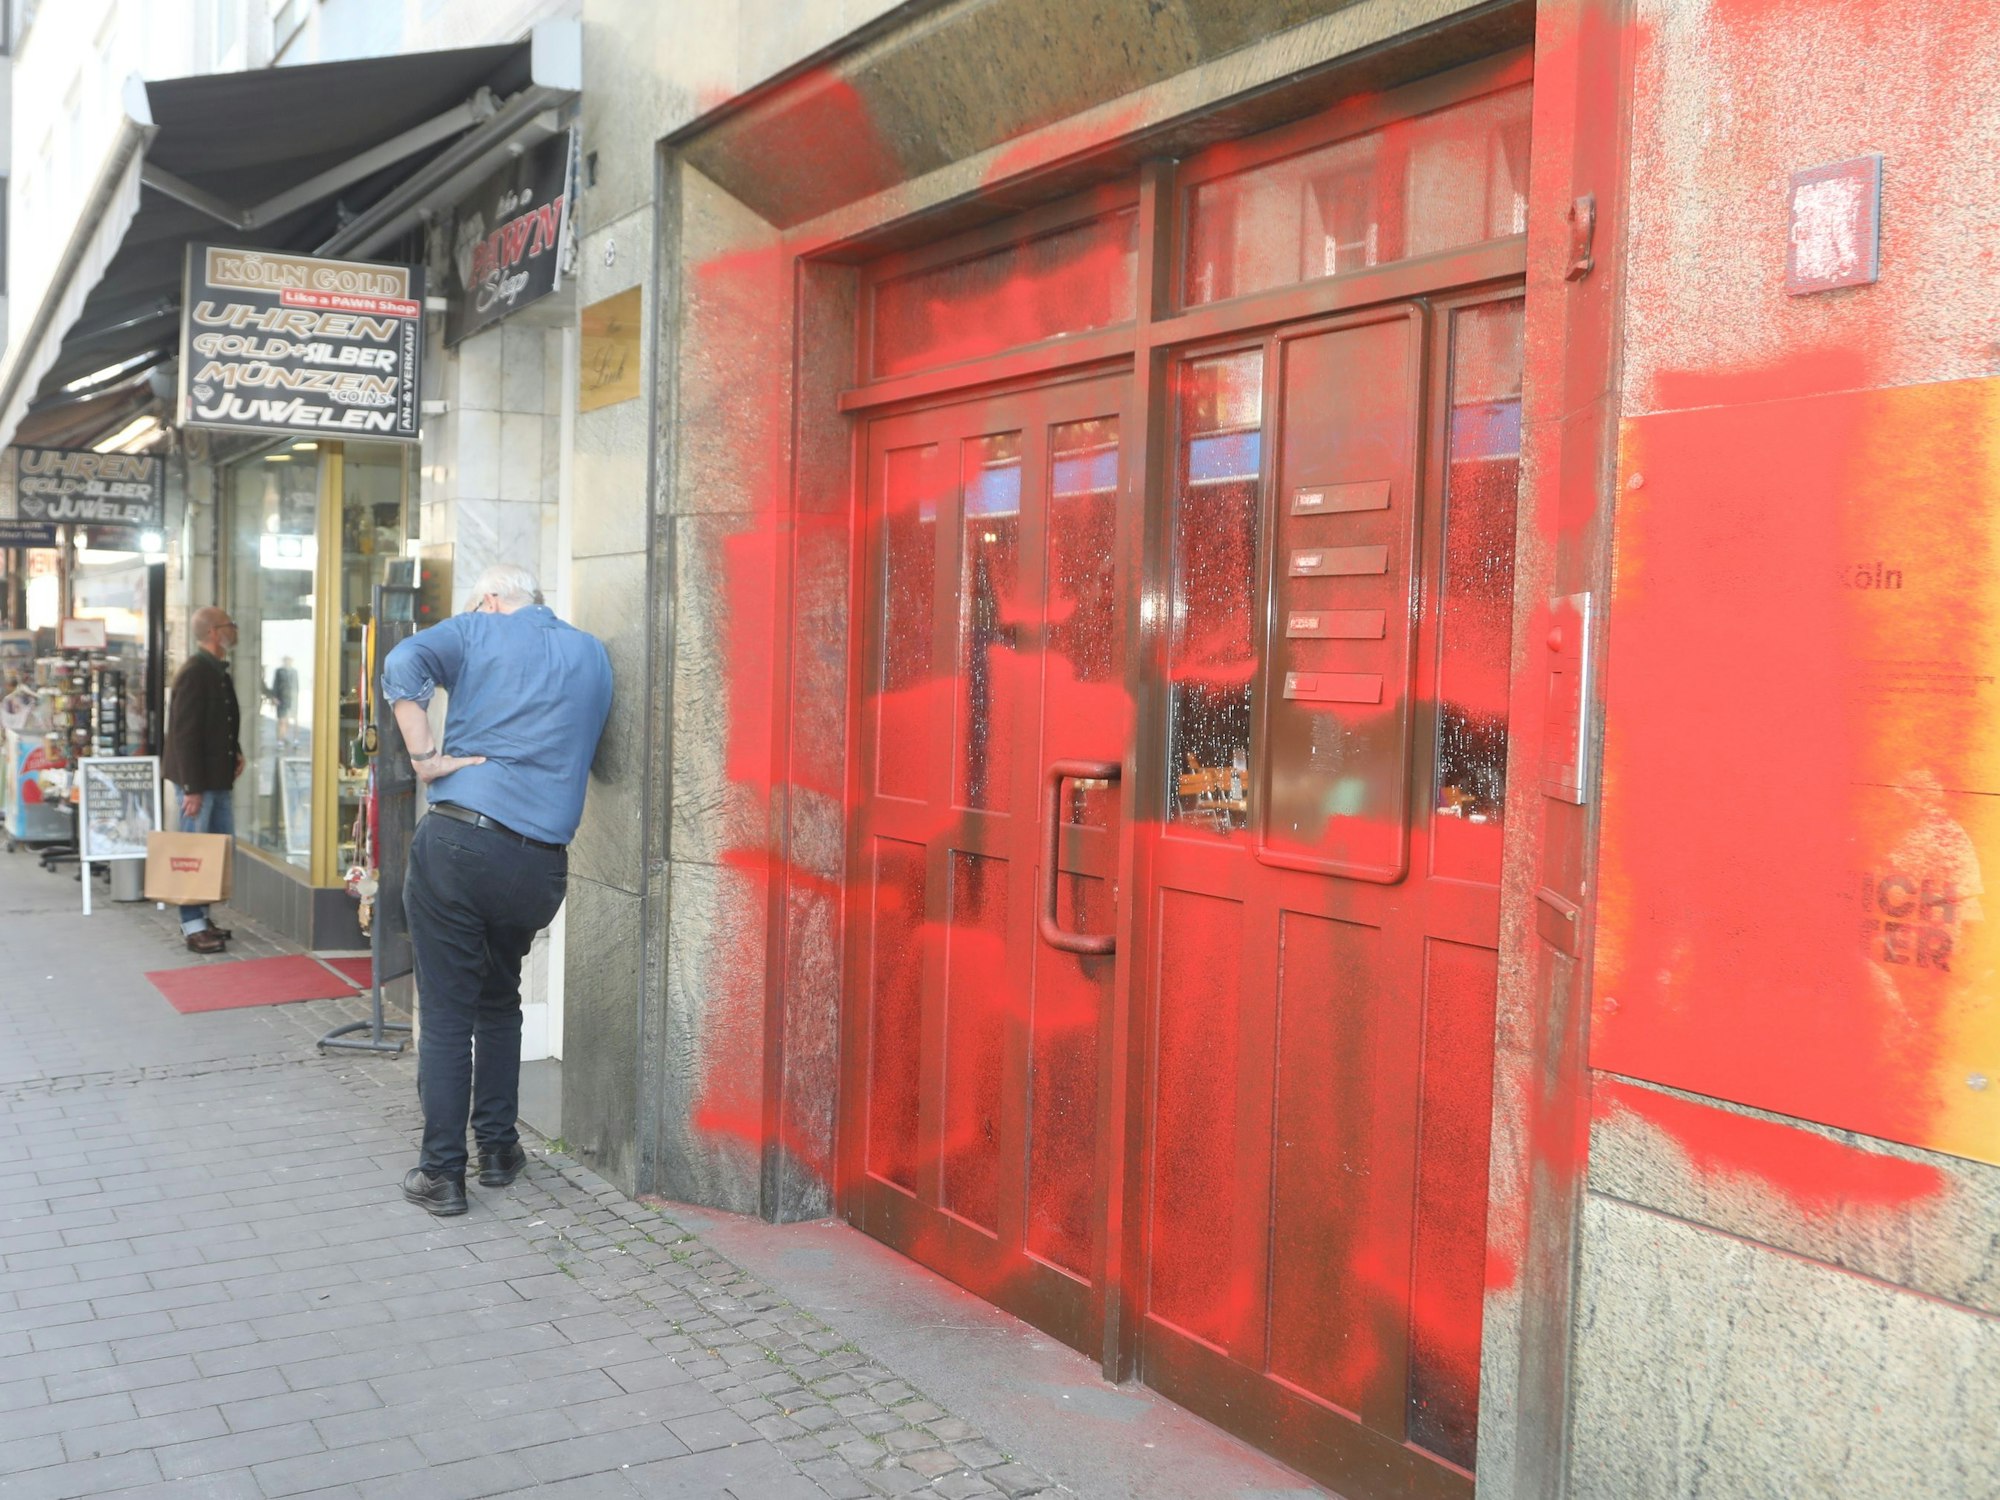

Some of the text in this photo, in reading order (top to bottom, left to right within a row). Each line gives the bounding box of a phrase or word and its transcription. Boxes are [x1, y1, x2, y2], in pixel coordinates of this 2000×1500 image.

[216, 254, 400, 296] KÖLN GOLD
[285, 291, 416, 316] Like a PAWN Shop
[192, 301, 399, 343] UHREN
[403, 322, 415, 390] VERKAUF
[194, 361, 399, 396] MÜNZEN
[196, 392, 397, 431] JUWELEN
[336, 390, 388, 406] COINS
[20, 450, 153, 481] UHREN
[48, 495, 153, 521] JUWELEN
